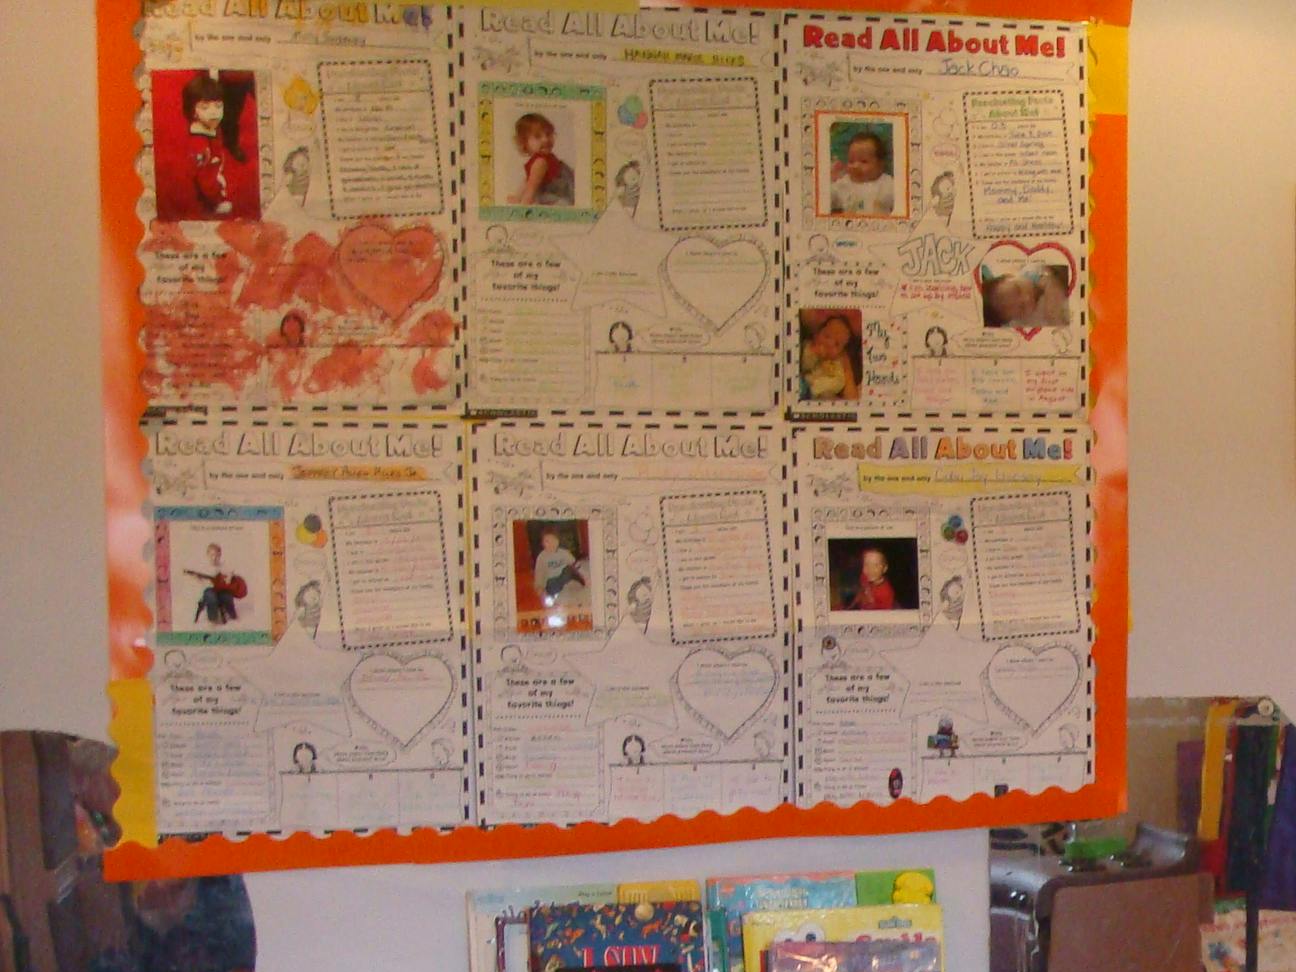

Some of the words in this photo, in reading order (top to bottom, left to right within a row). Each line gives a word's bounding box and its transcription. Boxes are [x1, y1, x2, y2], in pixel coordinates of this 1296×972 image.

[480, 7, 552, 35] Read
[561, 12, 602, 36] All
[611, 14, 698, 41] About
[705, 18, 760, 45] Me!
[803, 24, 873, 50] Read
[880, 27, 919, 51] All
[926, 30, 1011, 55] About
[1015, 34, 1066, 58] Me!
[853, 65, 863, 75] by
[864, 65, 877, 73] the
[878, 66, 891, 74] one
[893, 67, 906, 75] and
[907, 67, 923, 76] only
[941, 58, 975, 76] Jack
[897, 233, 976, 278] JACK
[813, 267, 836, 276] These
[838, 268, 853, 276] are
[864, 267, 880, 276] few
[834, 279, 844, 287] of
[845, 280, 859, 289] my
[155, 432, 228, 457] Read
[236, 432, 281, 457] All
[287, 432, 381, 459] About
[385, 433, 443, 459] Me!
[493, 432, 566, 457] Read
[573, 433, 615, 457] All
[620, 433, 709, 460] About
[713, 434, 769, 460] Me!
[813, 435, 883, 460] Read
[889, 435, 929, 460] All
[934, 435, 1017, 460] About
[1022, 436, 1074, 460] Me!
[826, 673, 848, 682] These
[850, 674, 865, 682] are
[875, 670, 891, 682] few
[846, 683, 856, 693] of
[857, 685, 870, 694] my
